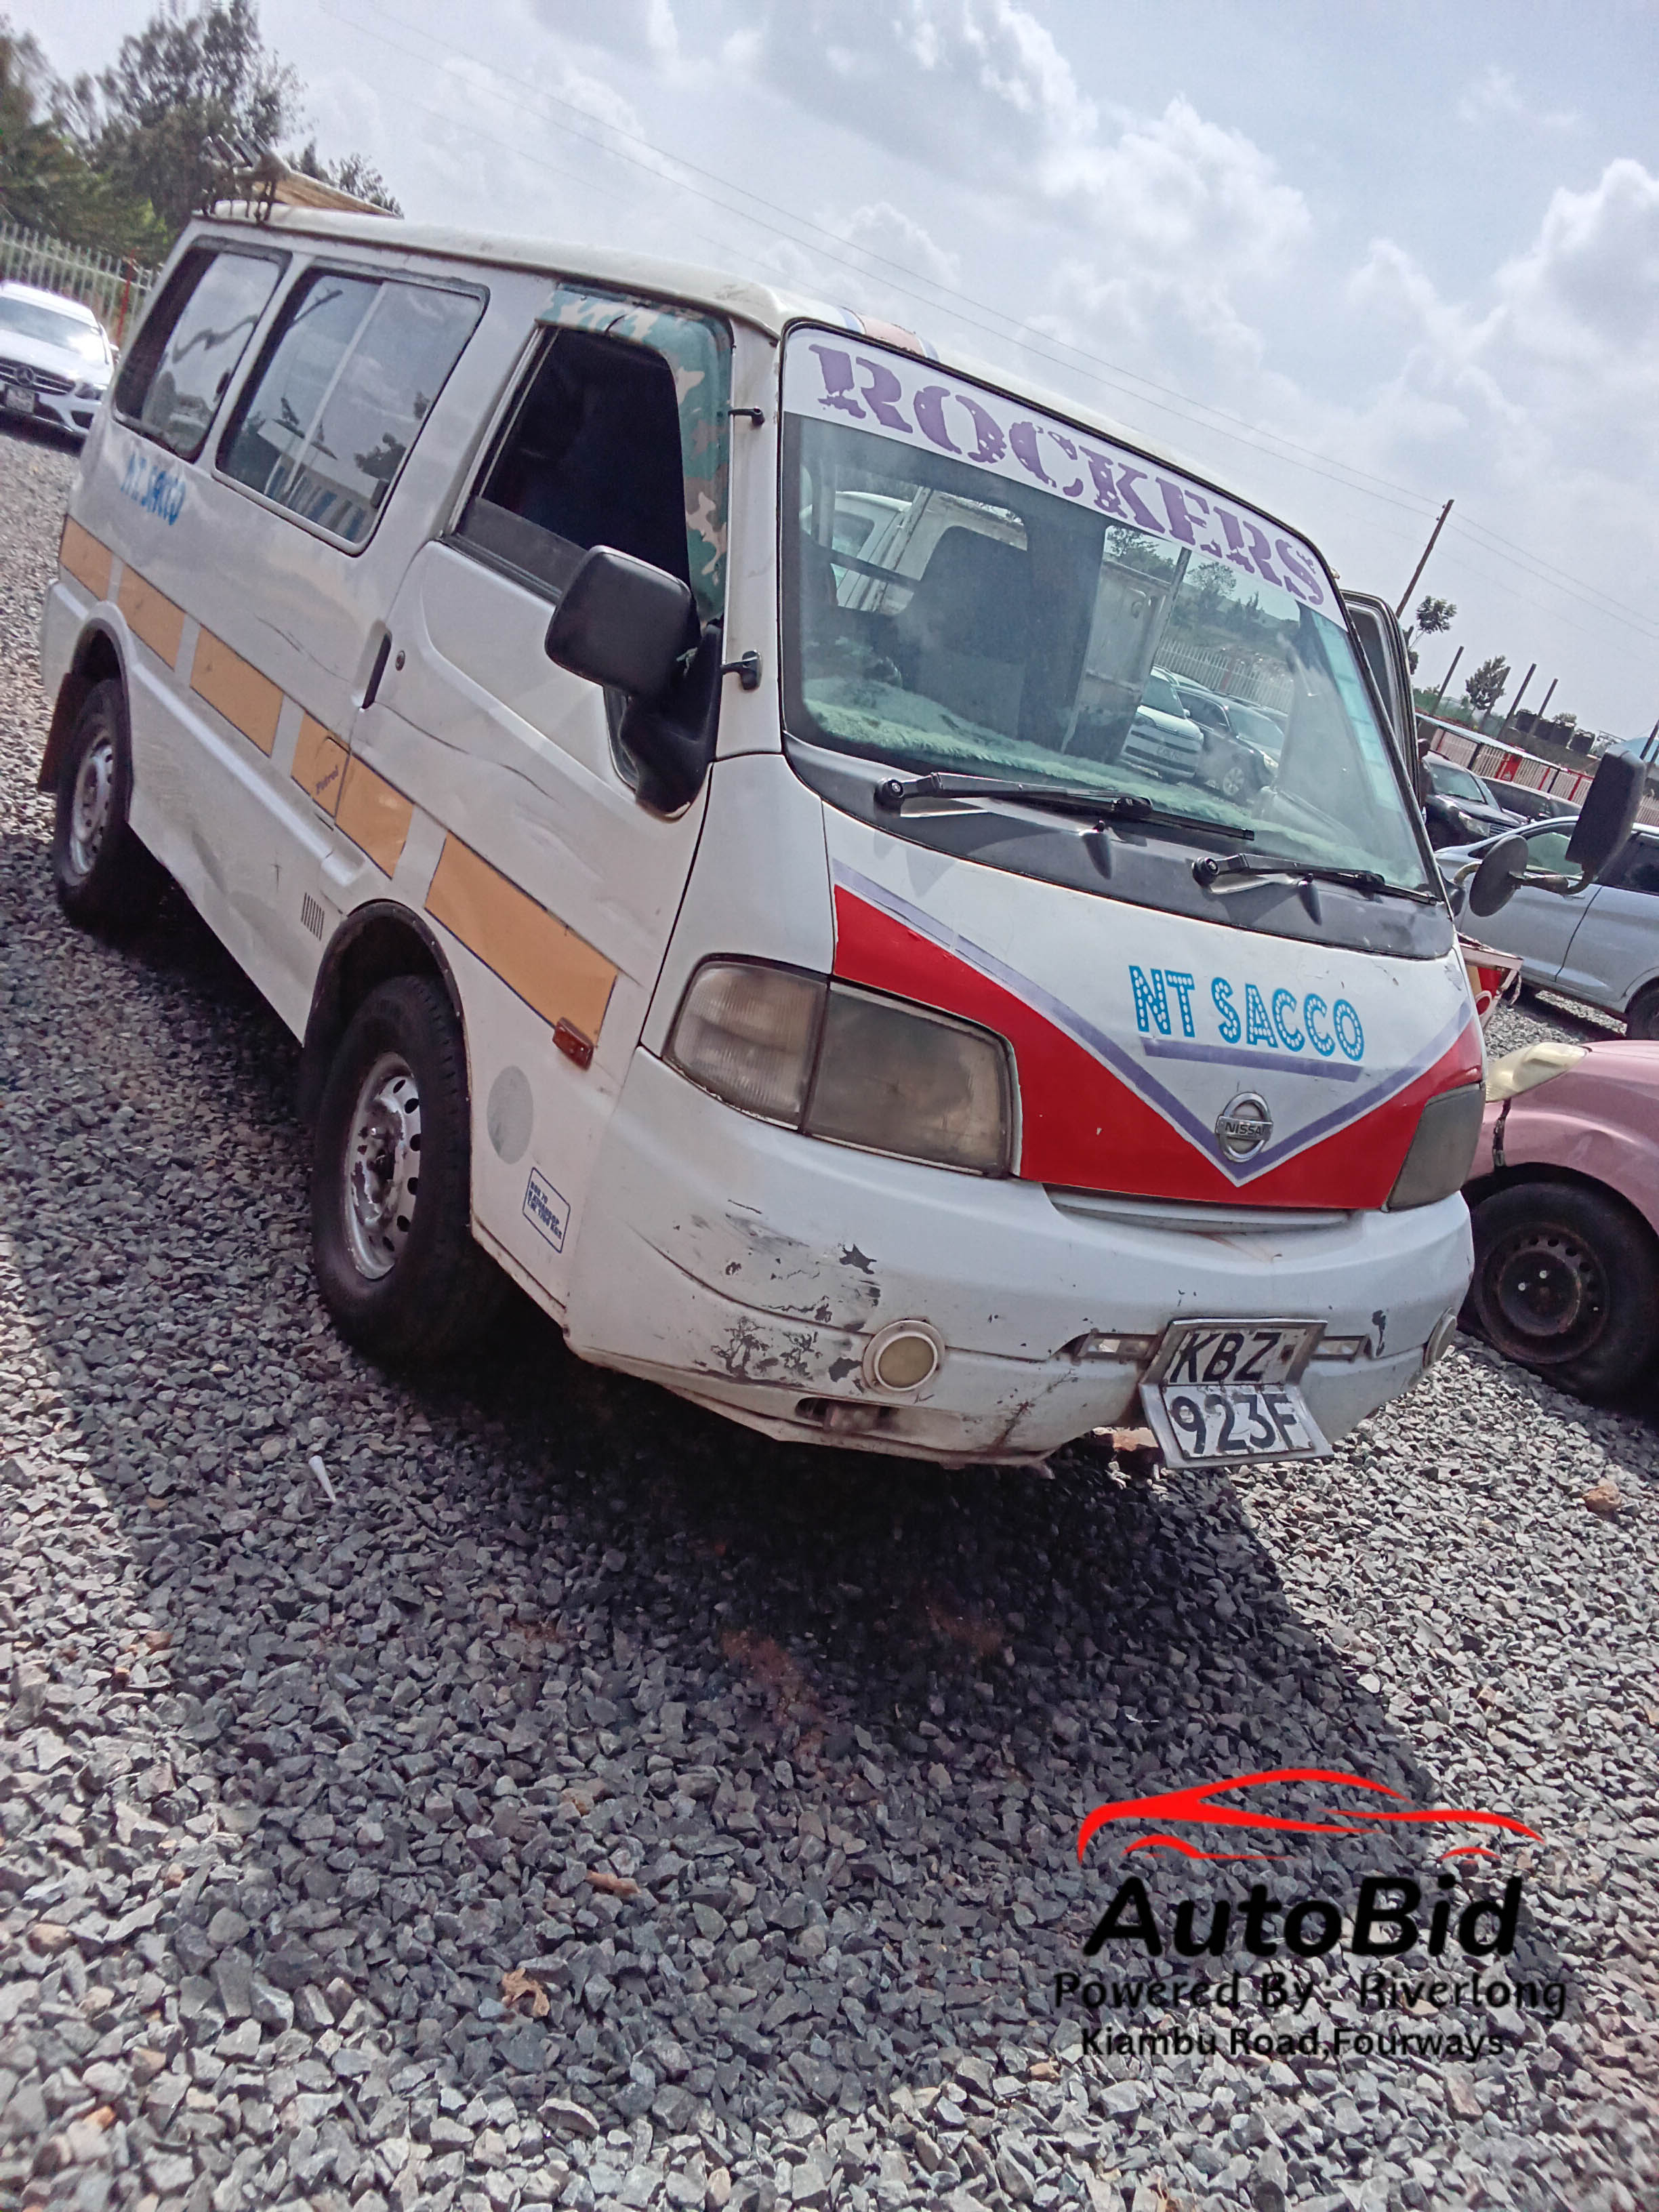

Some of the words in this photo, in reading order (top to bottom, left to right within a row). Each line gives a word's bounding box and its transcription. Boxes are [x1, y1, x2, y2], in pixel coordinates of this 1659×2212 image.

[809, 344, 1325, 606] ROCKERS
[1128, 965, 1195, 1038] NT
[1211, 977, 1364, 1061] SACCO
[1169, 1332, 1282, 1383] KBZ
[1171, 1393, 1298, 1454] 923F
